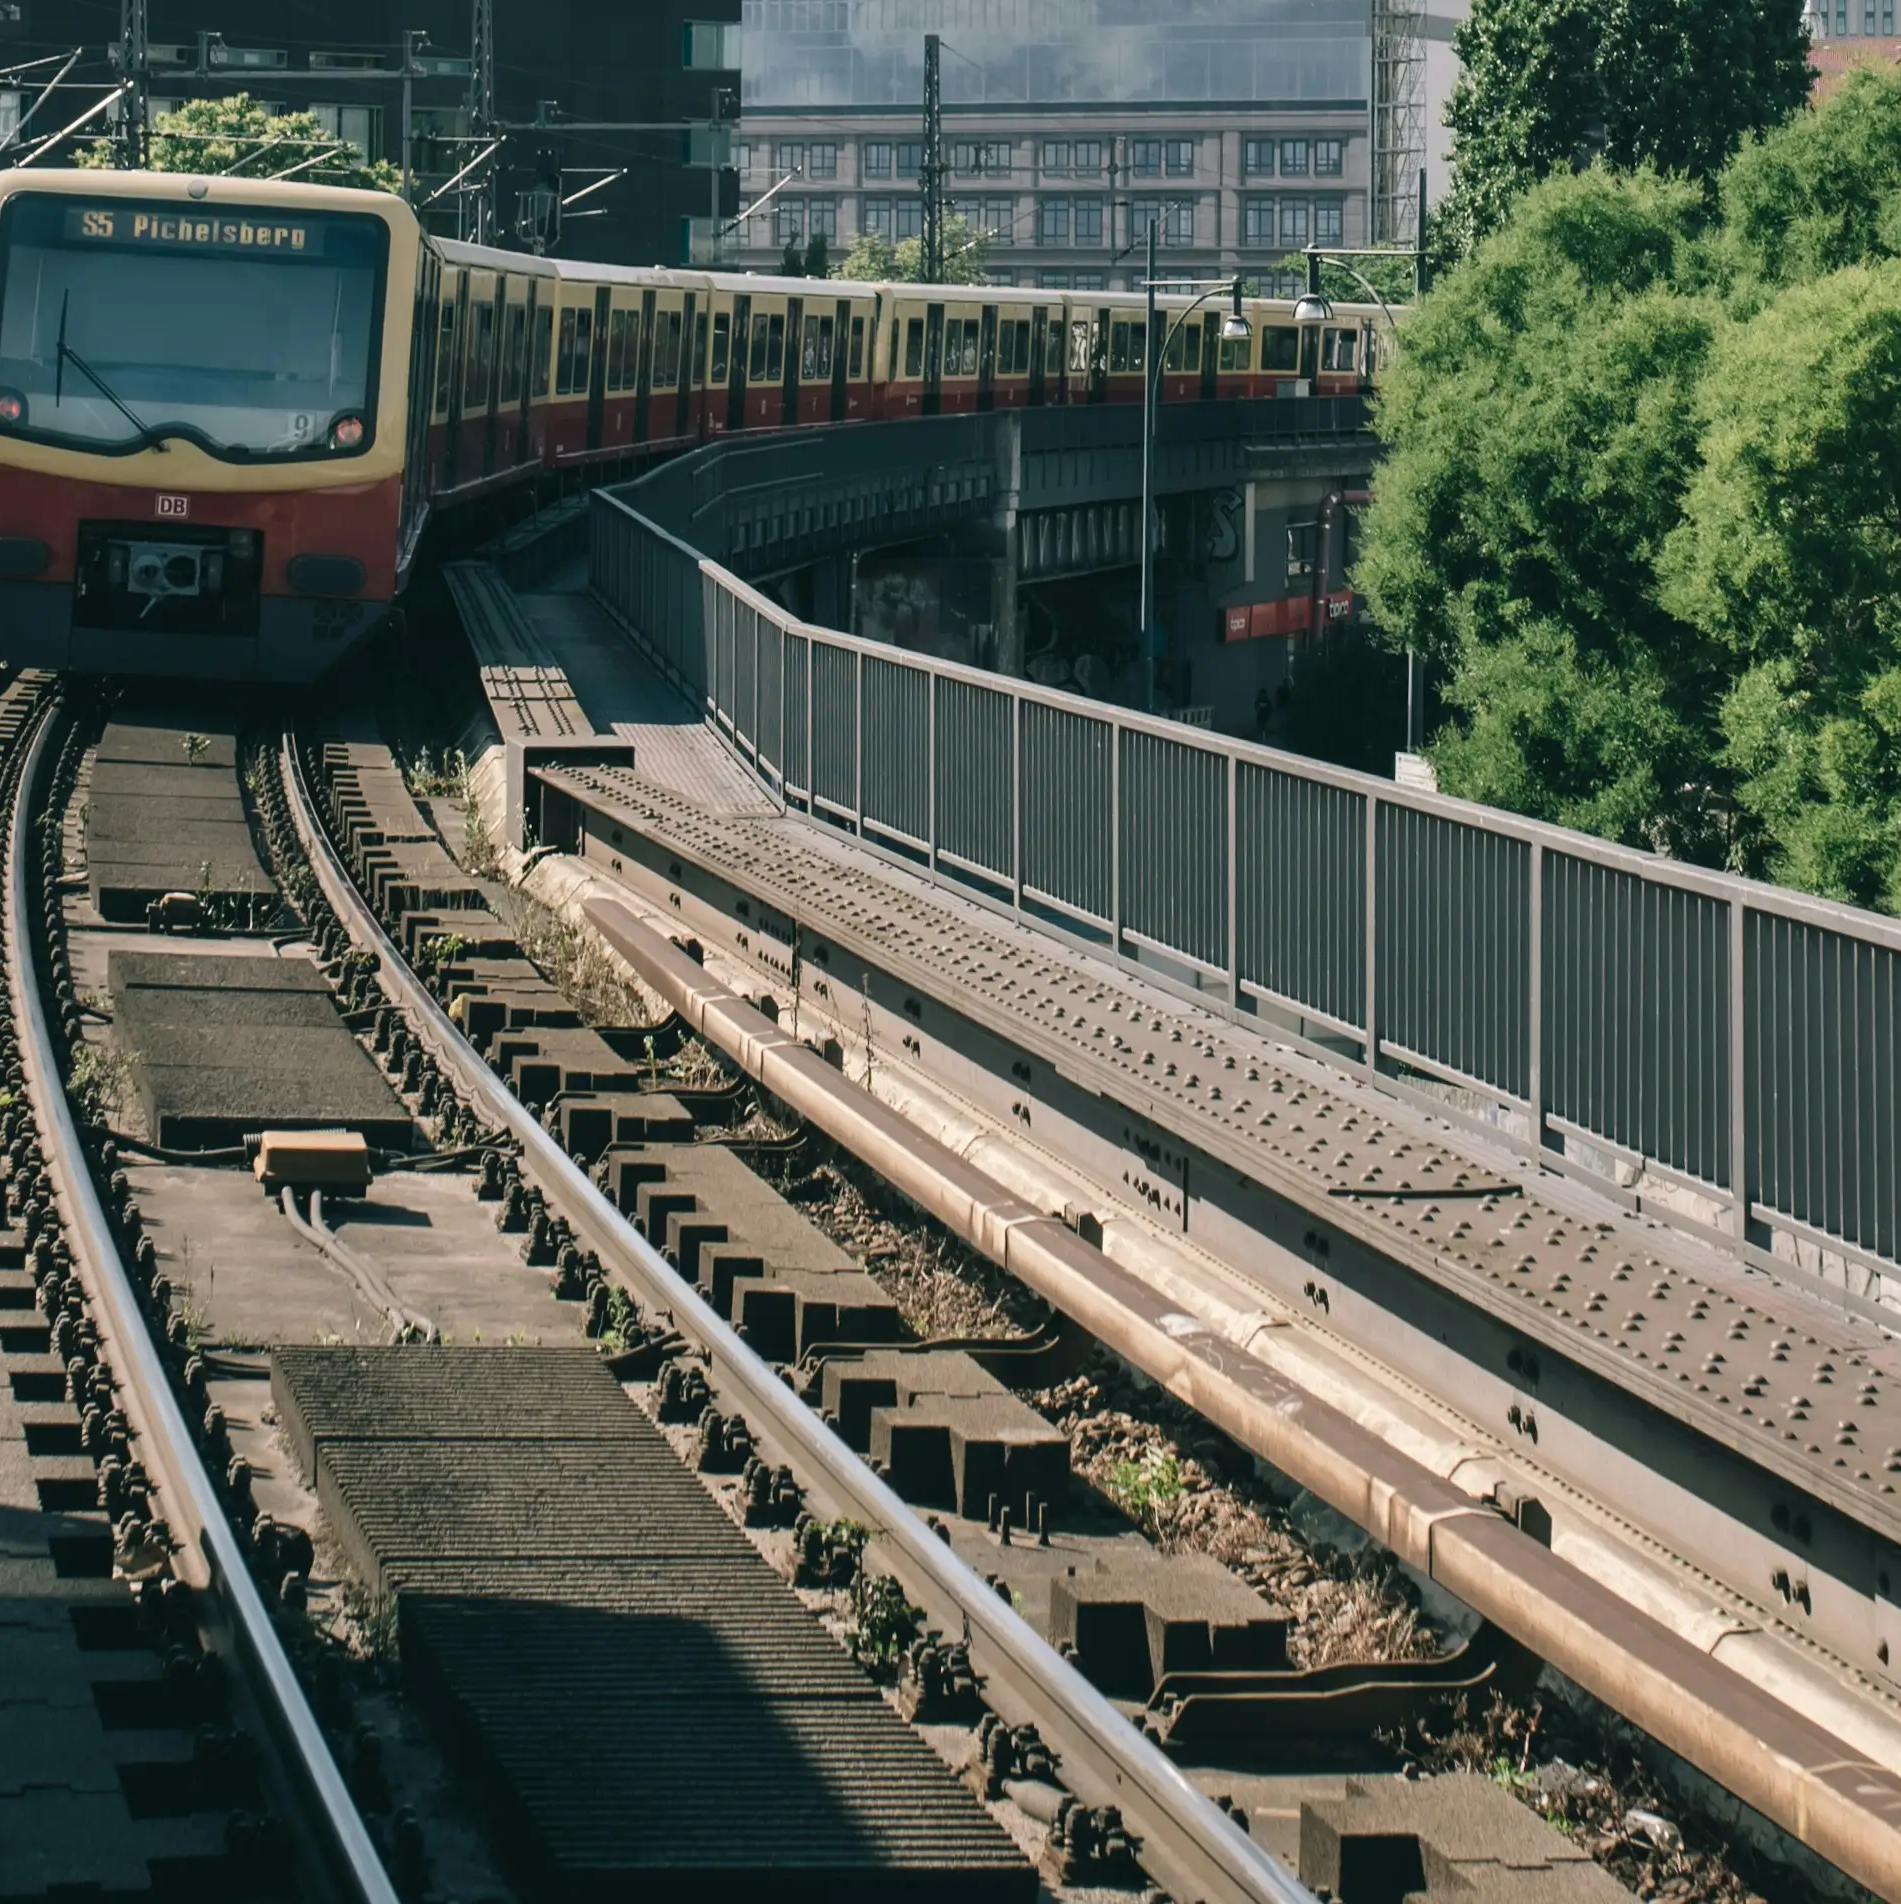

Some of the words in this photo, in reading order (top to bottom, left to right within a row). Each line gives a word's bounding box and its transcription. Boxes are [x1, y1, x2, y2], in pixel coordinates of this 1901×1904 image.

[82, 211, 114, 238] S5
[134, 214, 305, 250] Pichelsberg
[294, 415, 309, 439] 9
[159, 497, 186, 515] DB
